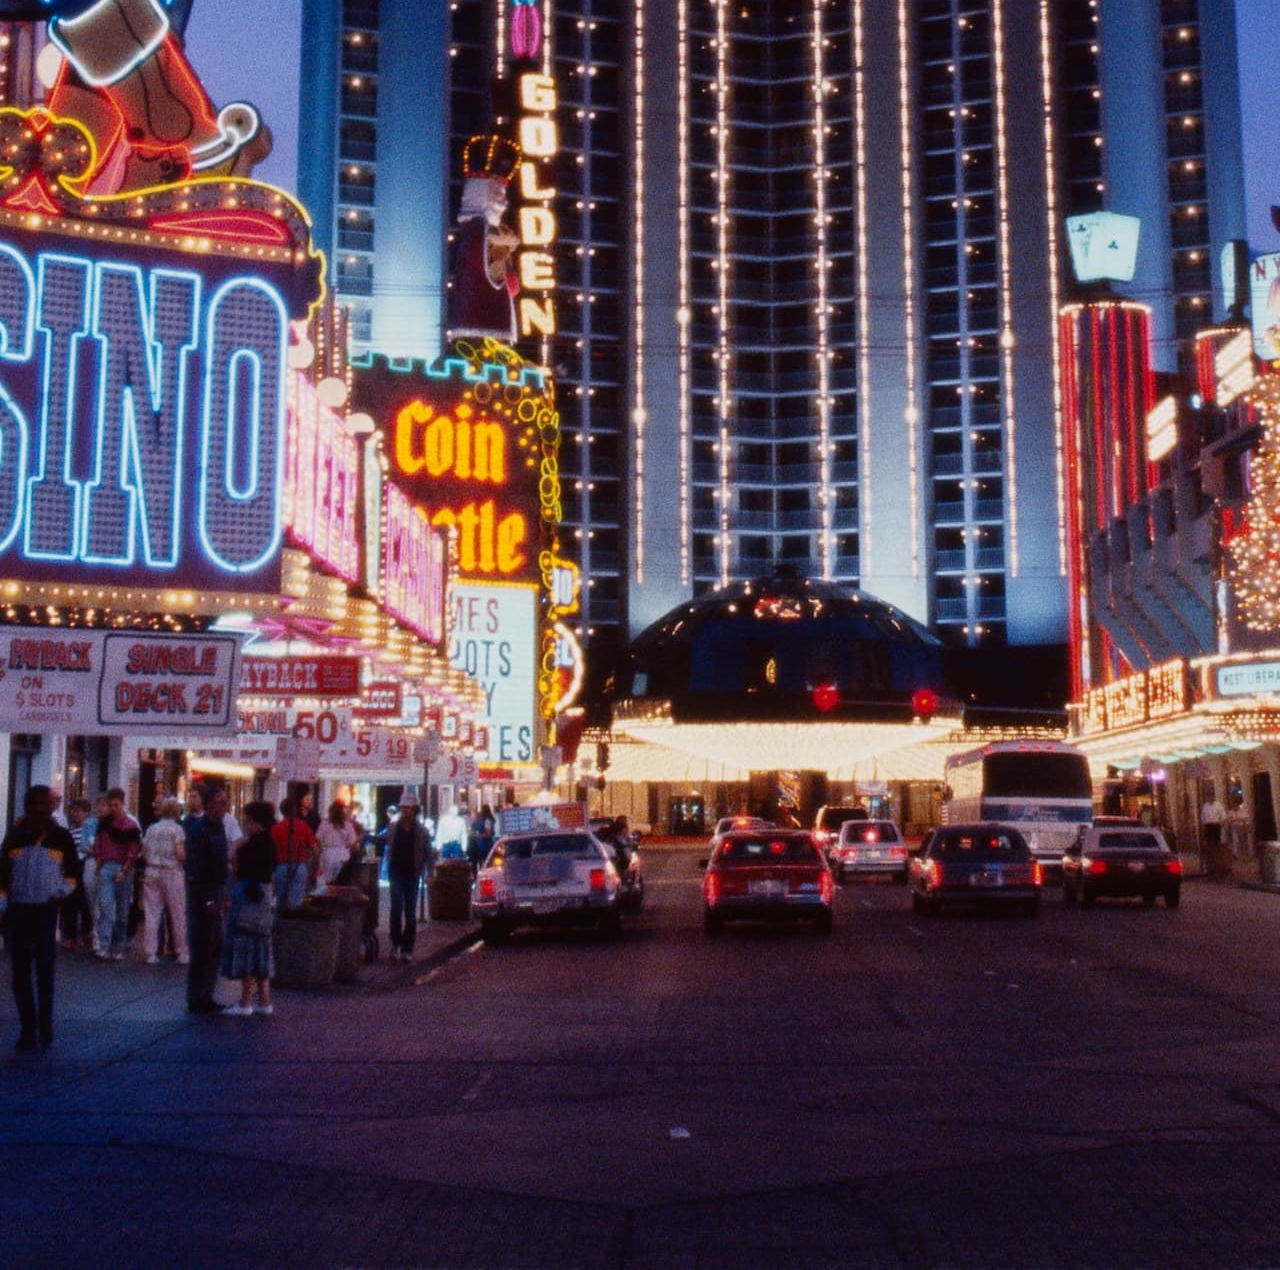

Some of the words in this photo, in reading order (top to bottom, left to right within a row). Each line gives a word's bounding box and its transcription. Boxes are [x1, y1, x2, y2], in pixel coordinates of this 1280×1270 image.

[520, 73, 558, 336] GOLDEN
[396, 399, 506, 484] Coin
[415, 499, 526, 573] tle
[125, 642, 219, 675] SINGLE
[21, 675, 44, 690] ON
[115, 681, 188, 714] DECK
[193, 684, 222, 715] 21
[30, 693, 76, 708] SLOTS
